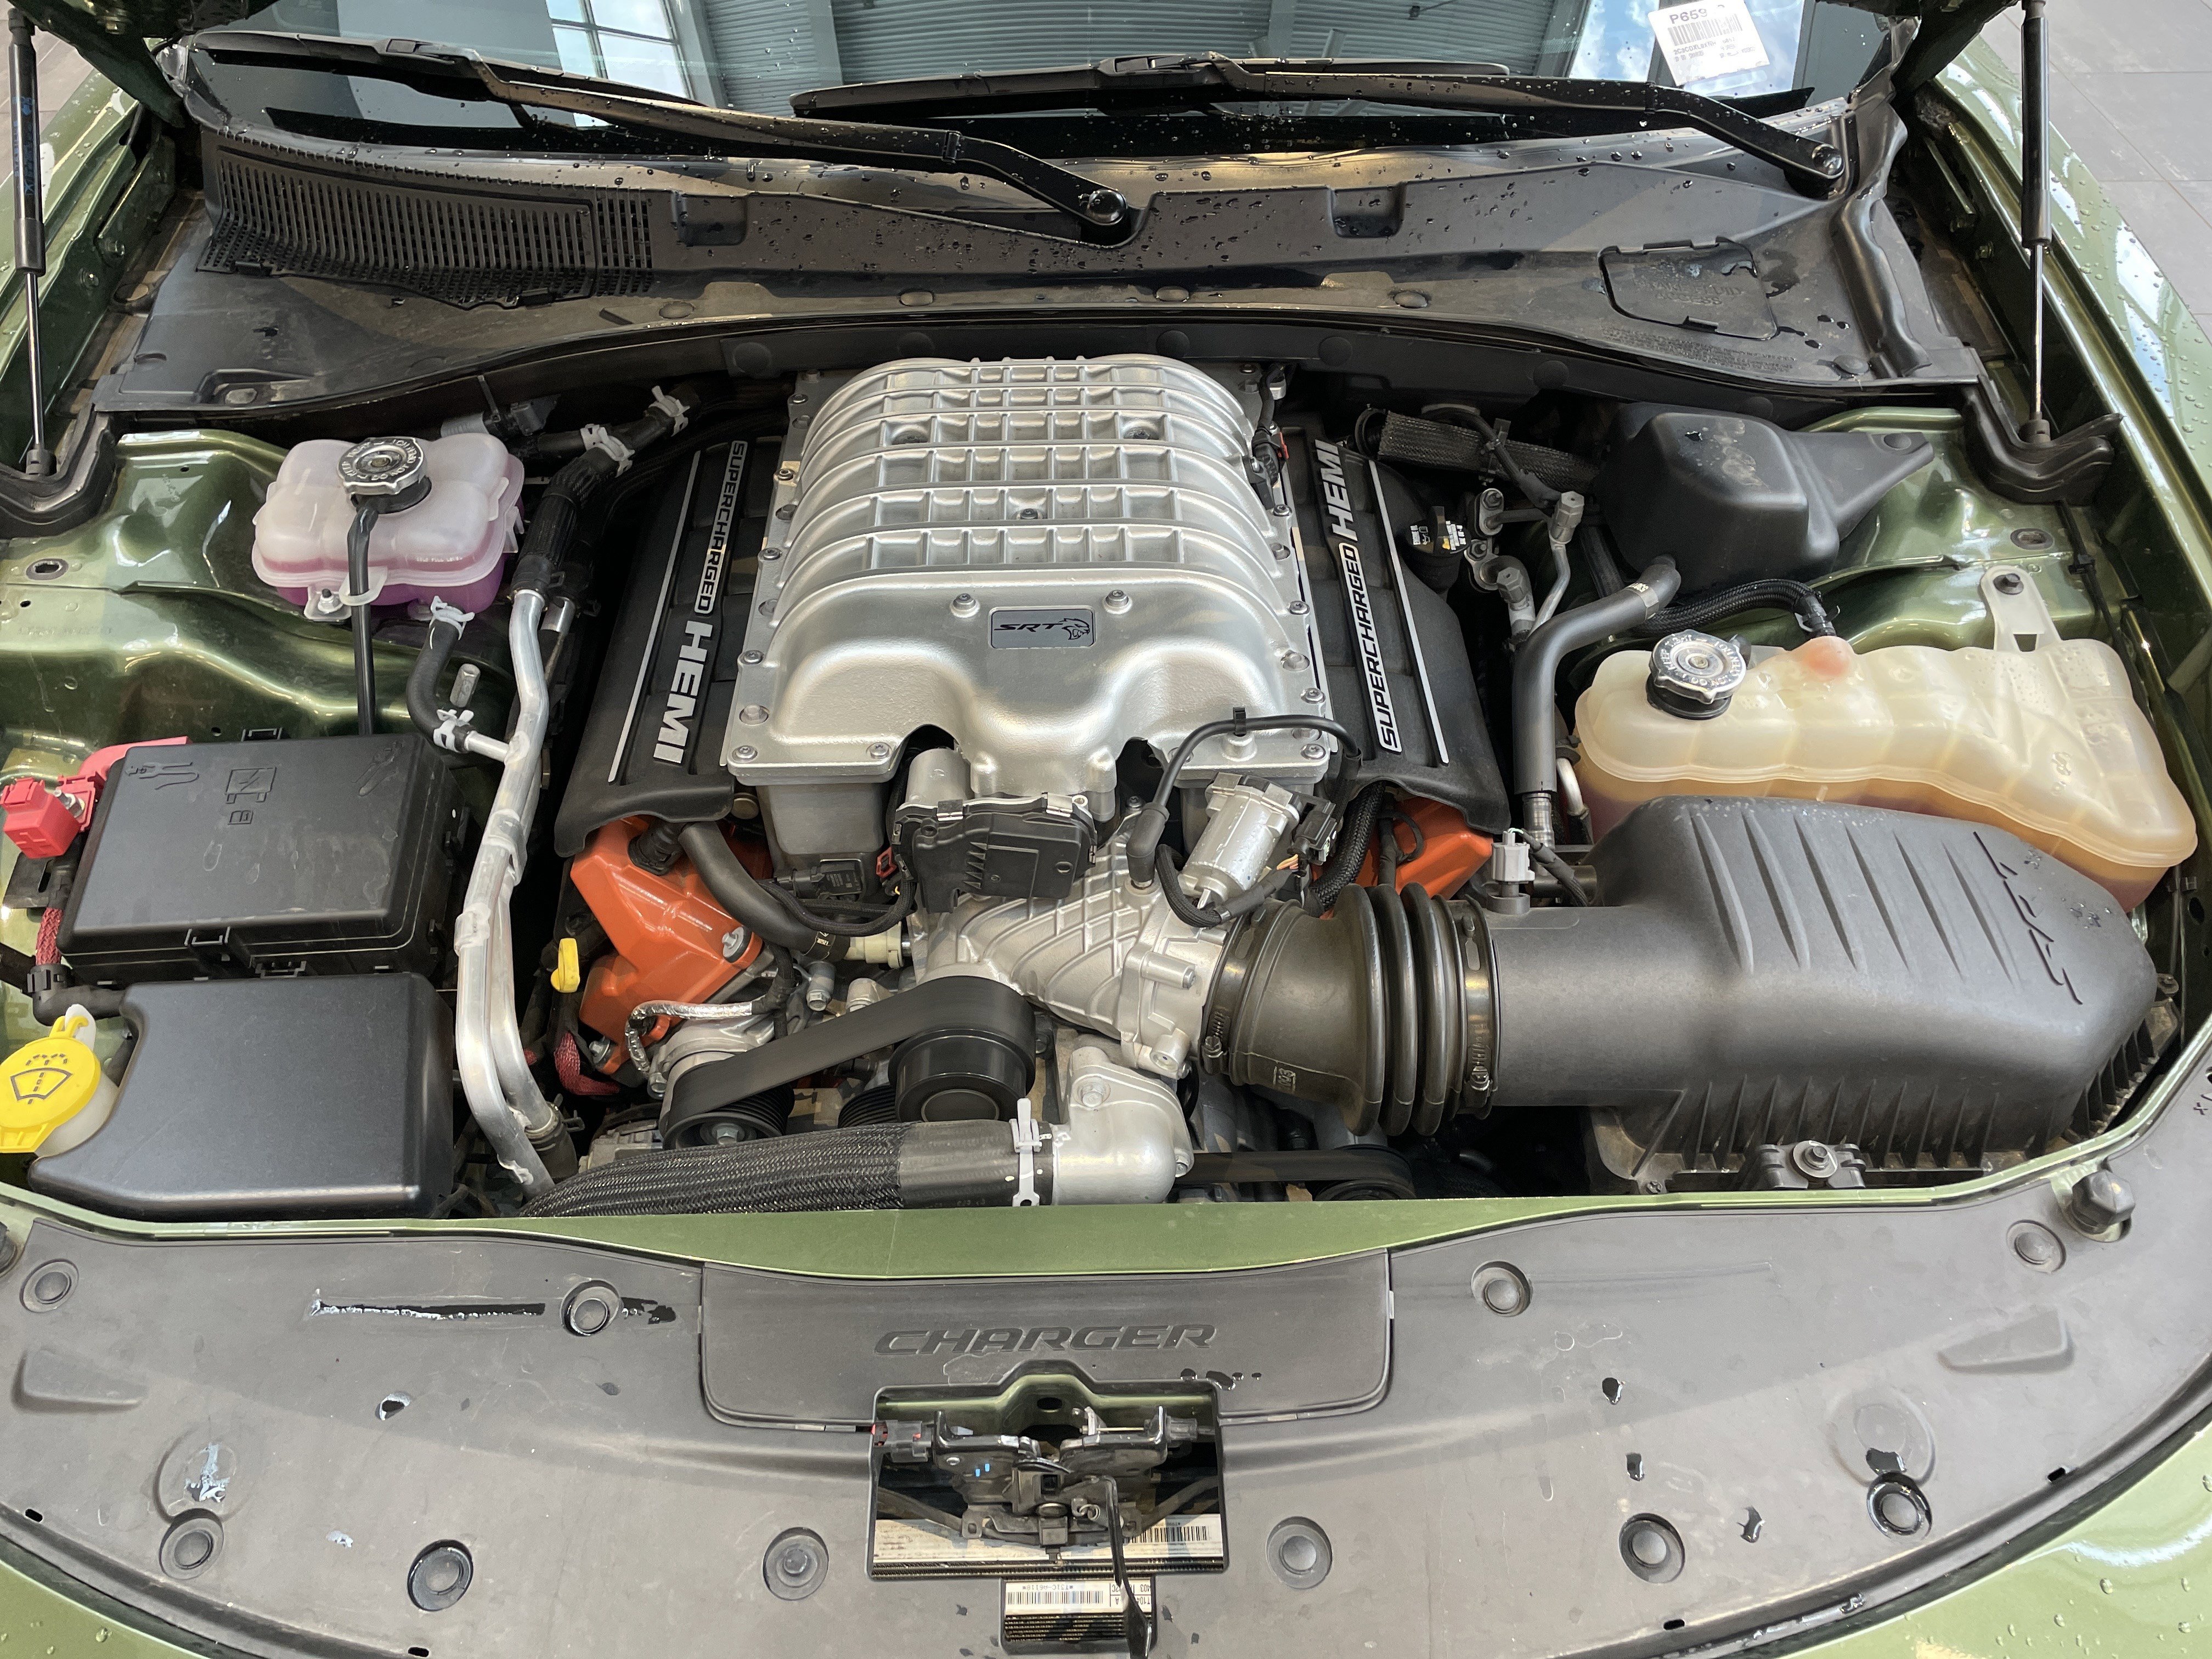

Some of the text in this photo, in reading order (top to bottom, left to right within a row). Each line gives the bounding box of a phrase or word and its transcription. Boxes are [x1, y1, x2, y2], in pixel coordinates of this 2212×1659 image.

[1314, 439, 1358, 540] HEMI
[653, 442, 746, 764] SUPERCHARGED HEMI
[994, 623, 1063, 632] SRT
[1340, 543, 1401, 751] SUPERCHARGED
[874, 1323, 1216, 1355] CHARGER
